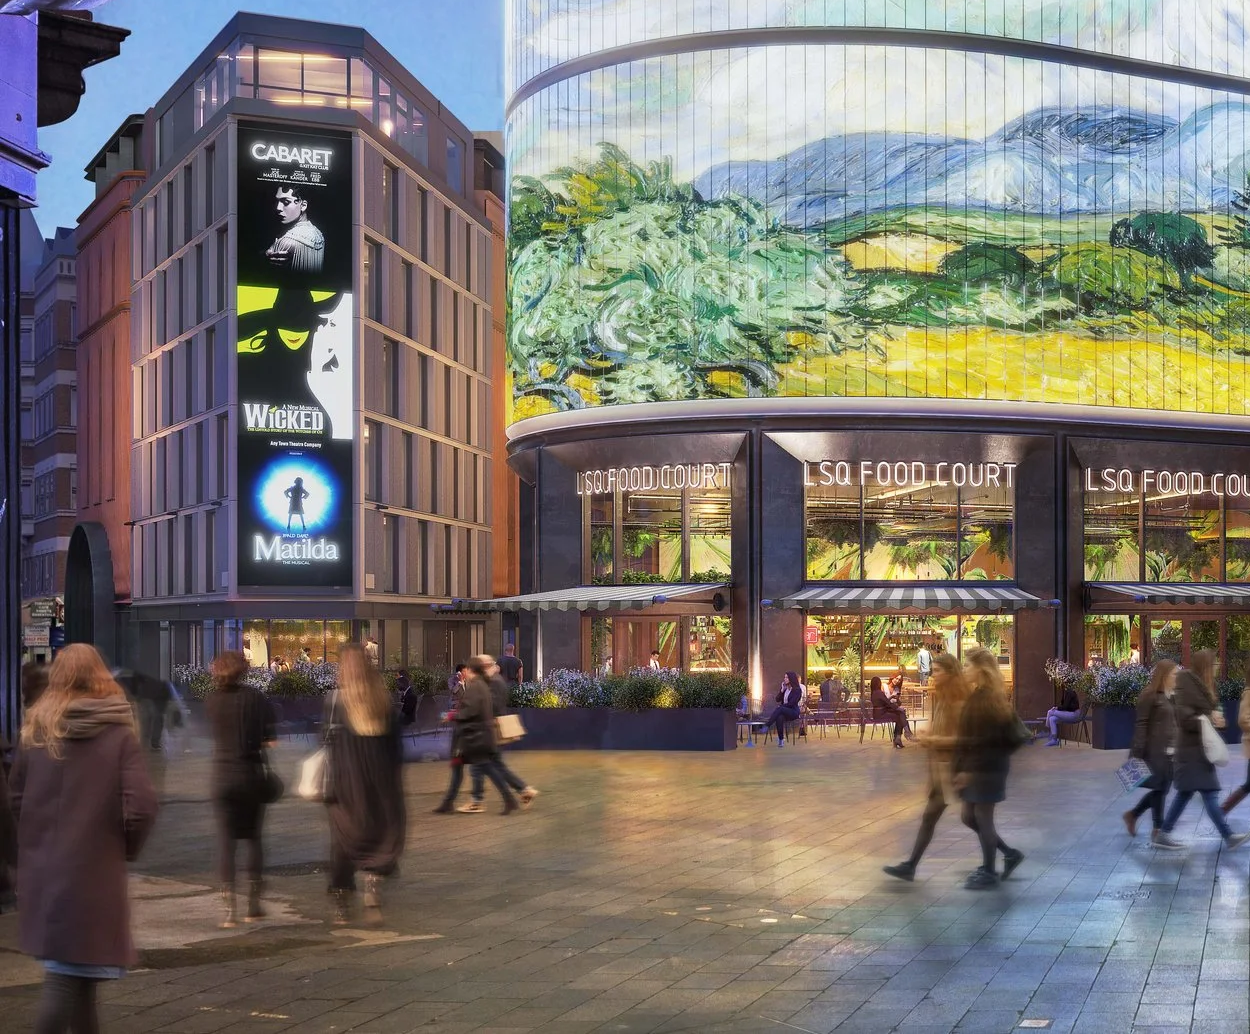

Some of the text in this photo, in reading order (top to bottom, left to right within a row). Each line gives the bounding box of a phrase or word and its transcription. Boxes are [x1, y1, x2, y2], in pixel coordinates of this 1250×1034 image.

[252, 144, 332, 166] CABARET
[608, 466, 654, 492] FOOD
[661, 462, 731, 489] COURT
[803, 462, 1017, 488] LSQ FOOD COURT
[1085, 467, 1134, 493] LSQ
[1142, 470, 1204, 495] FOOD
[254, 535, 339, 561] Matilda
